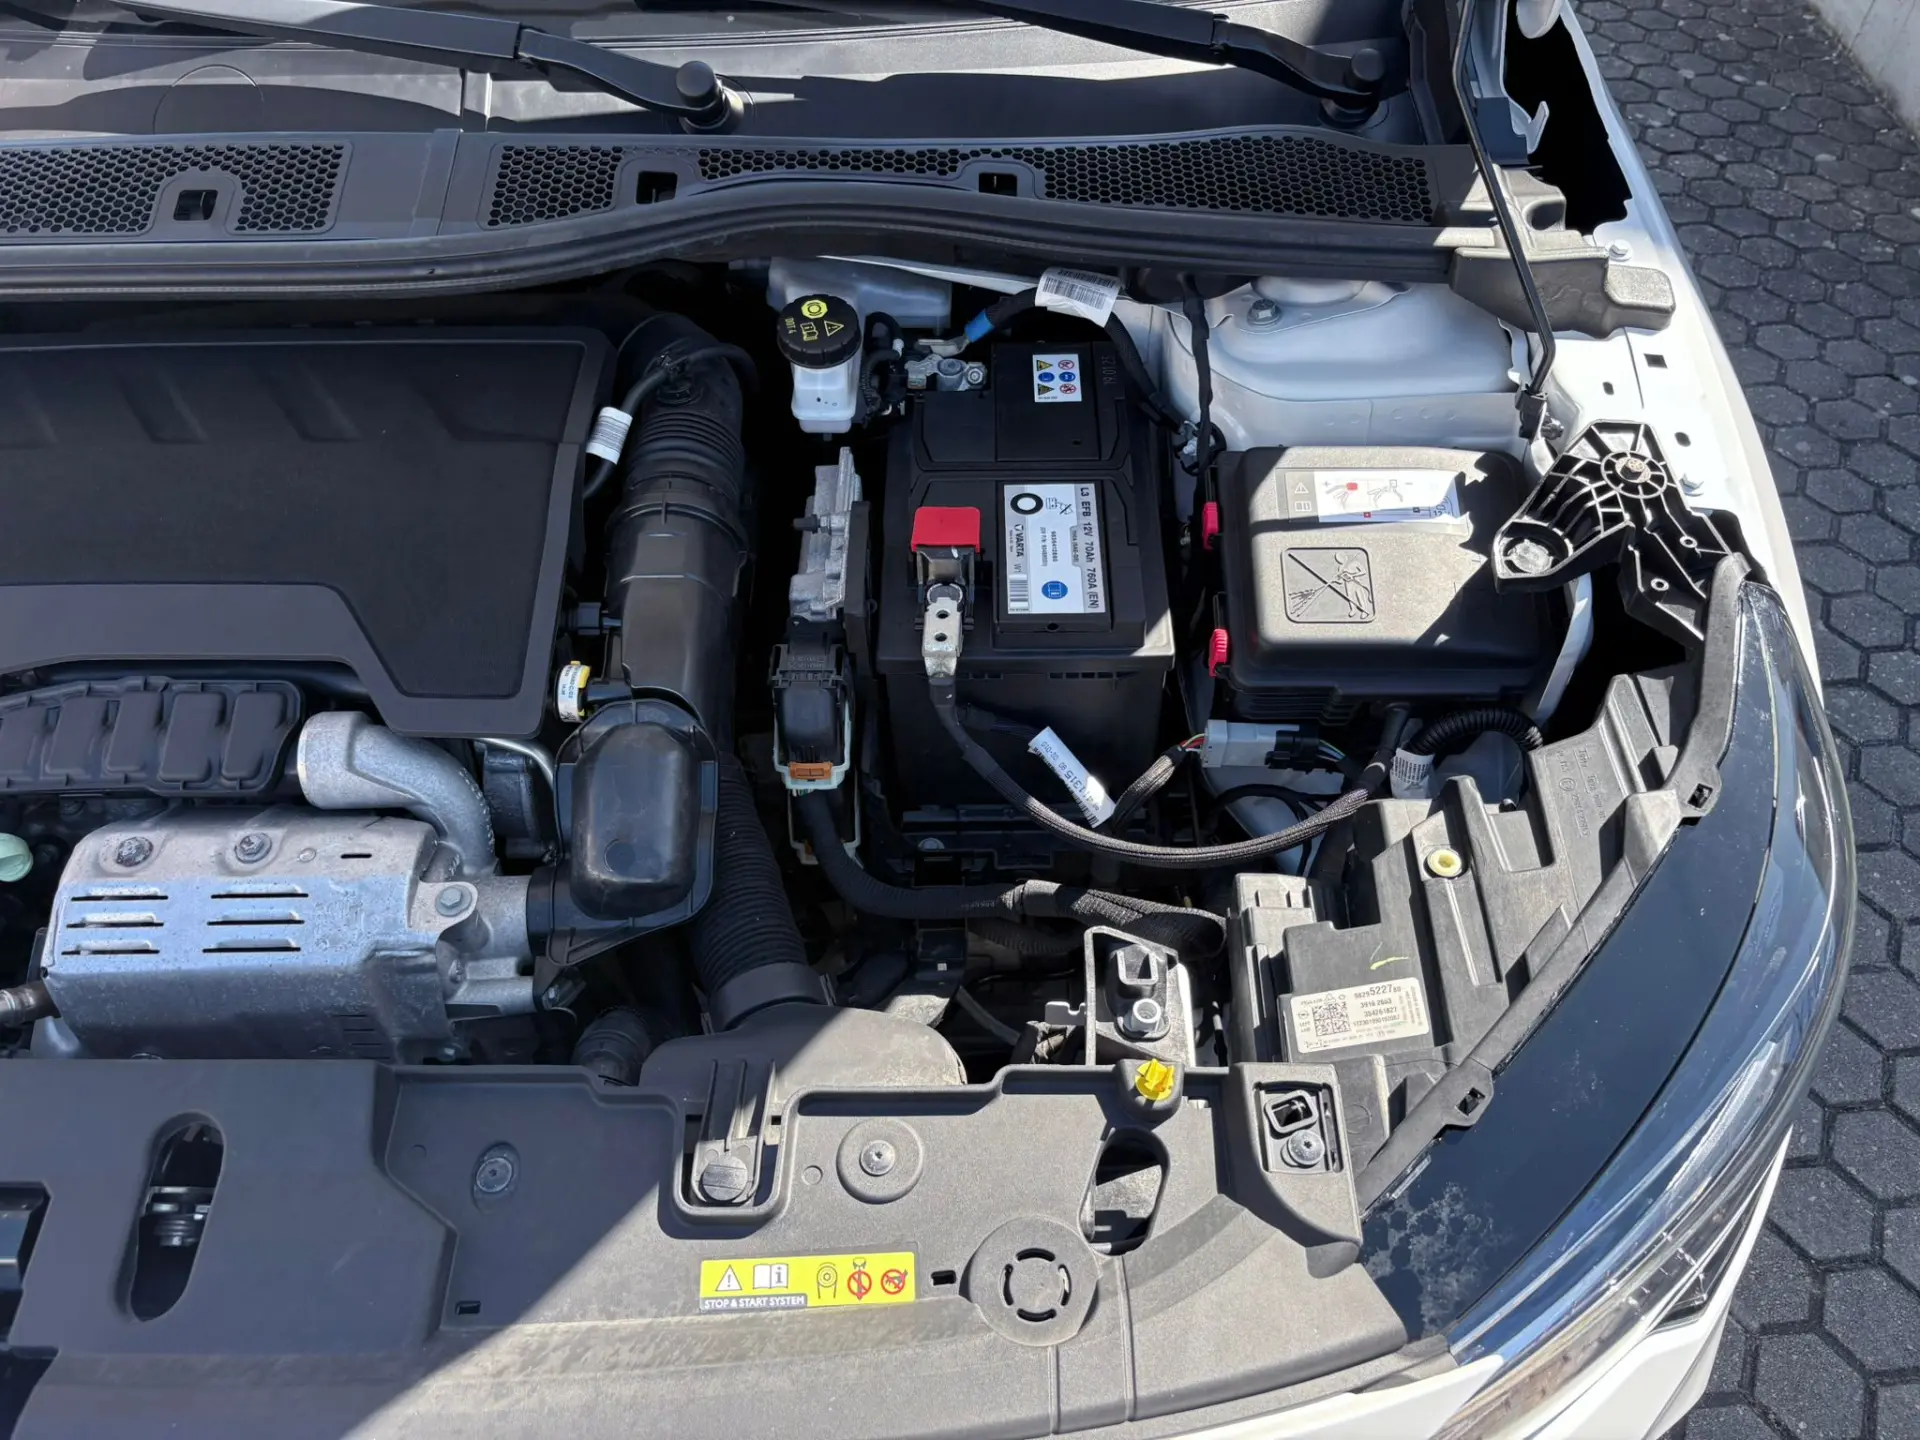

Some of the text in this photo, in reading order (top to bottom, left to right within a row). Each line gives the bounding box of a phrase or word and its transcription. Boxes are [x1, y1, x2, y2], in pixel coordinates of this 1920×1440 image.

[1015, 532, 1024, 557] VARTA
[1080, 487, 1099, 609] L3 EFB 12V 70Ah 760A (EN)
[704, 1295, 805, 1309] STOP & START SYSTEM
